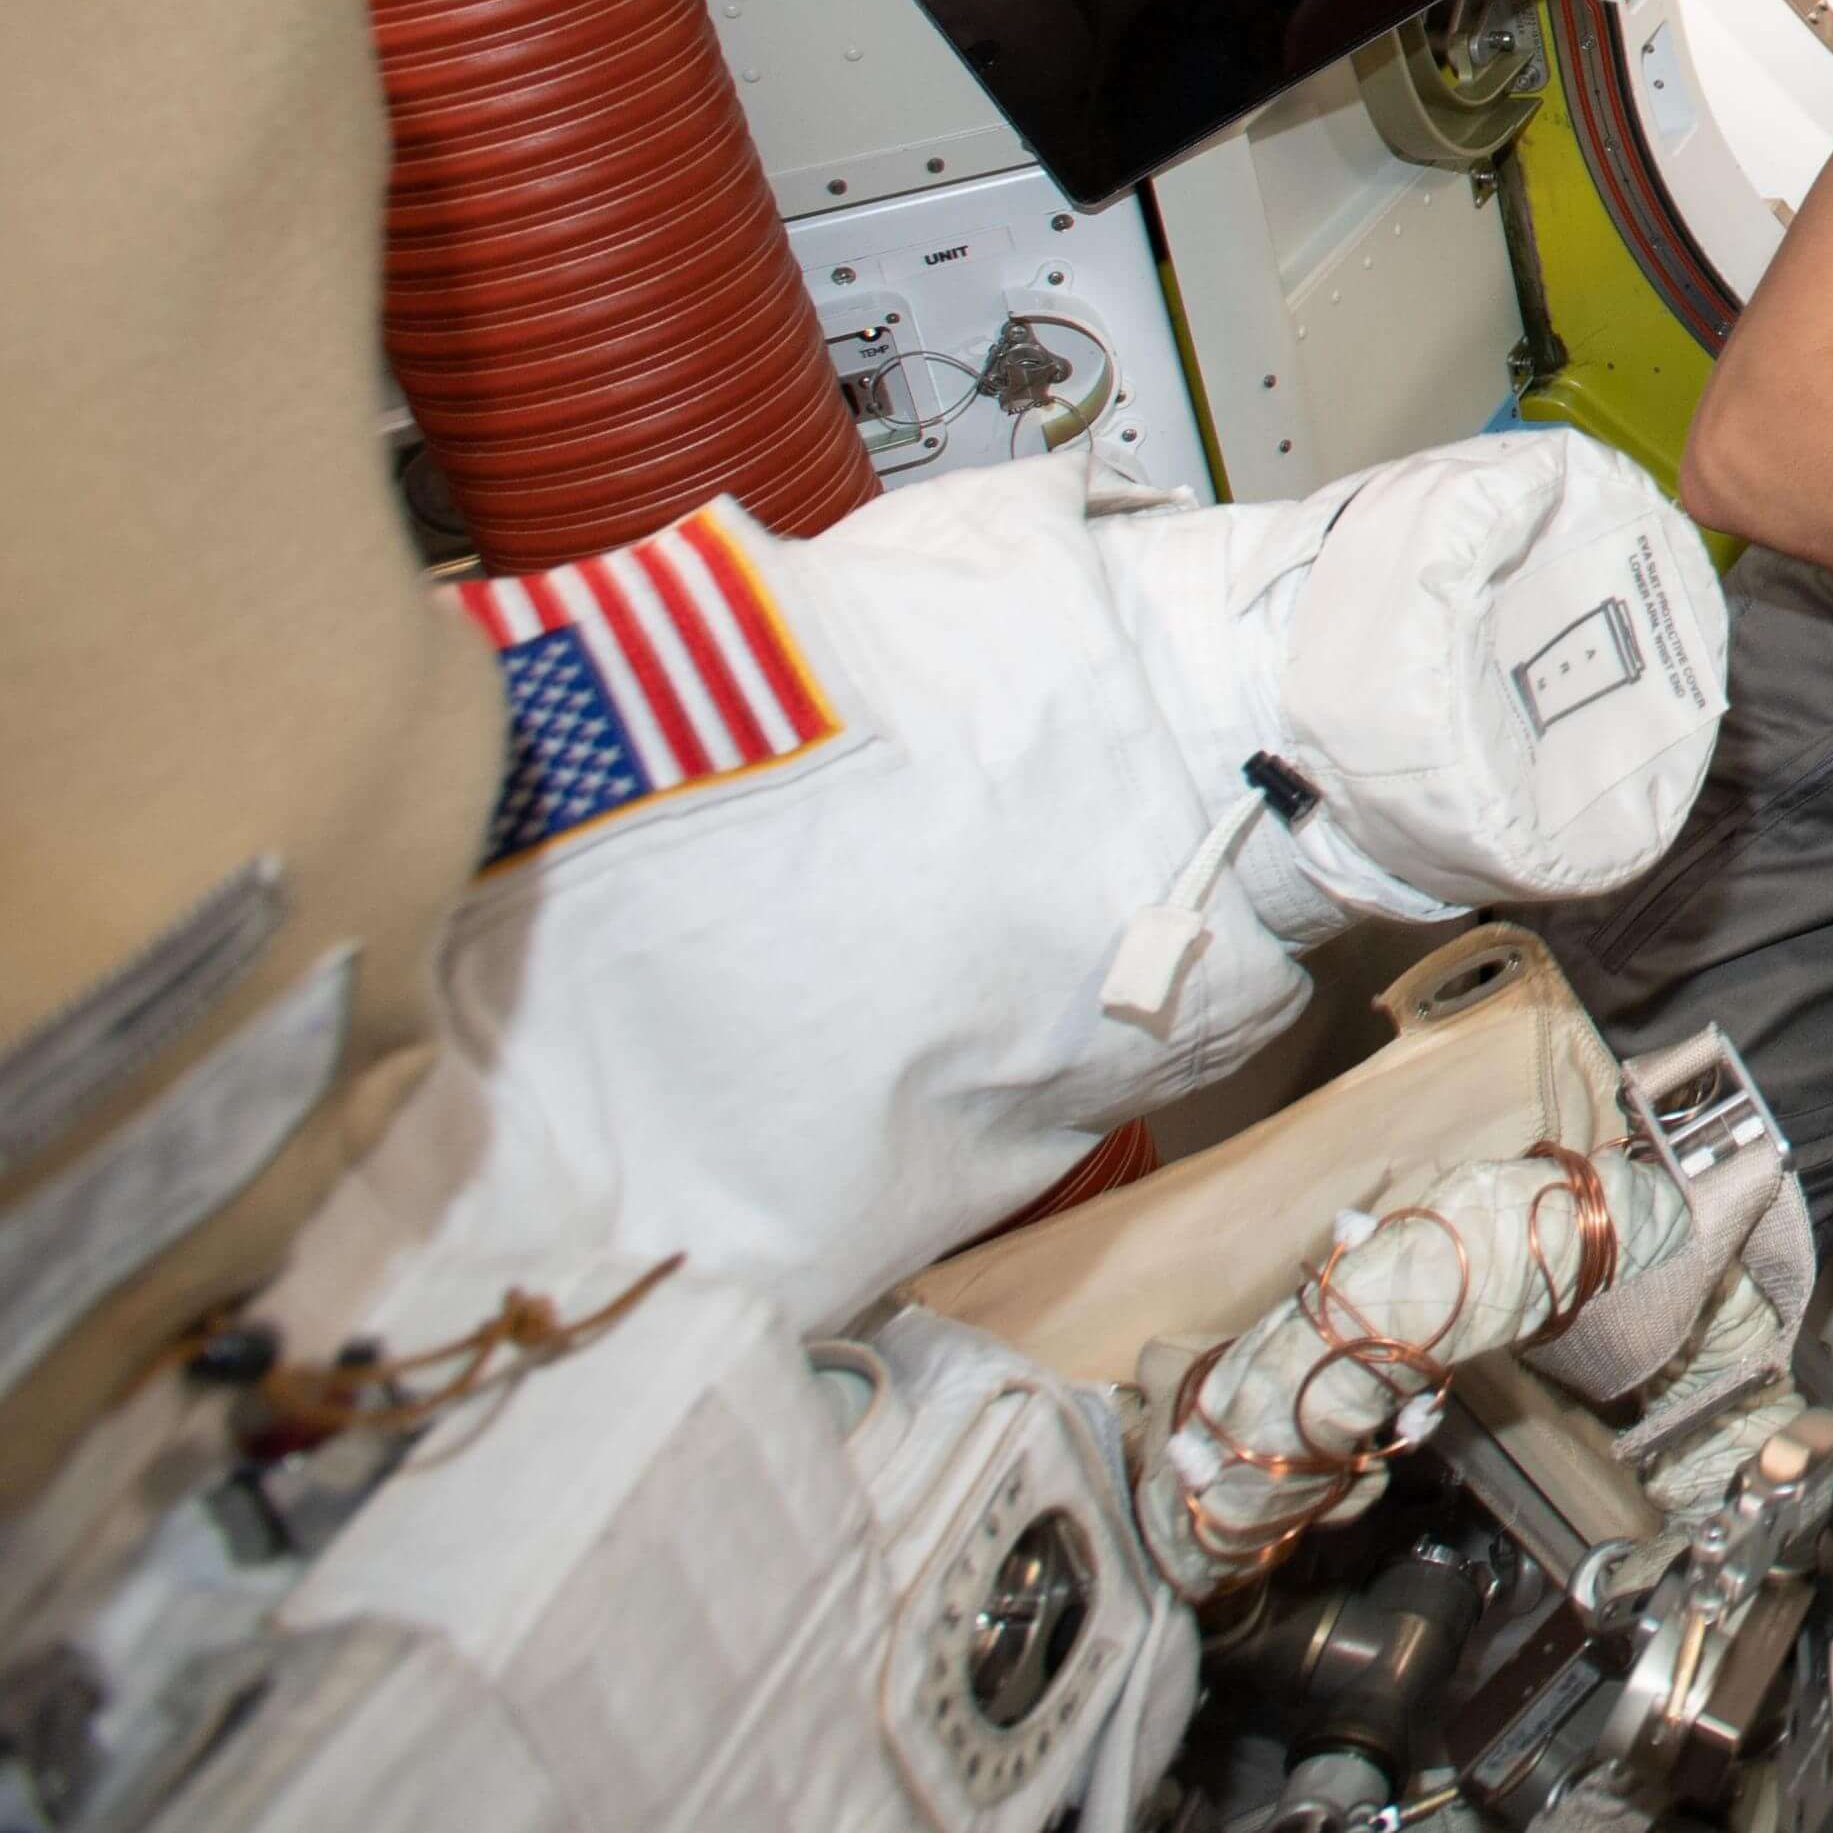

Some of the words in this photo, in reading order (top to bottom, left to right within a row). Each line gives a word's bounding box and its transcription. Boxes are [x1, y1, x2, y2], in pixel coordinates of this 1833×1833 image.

[924, 245, 969, 267] UNIT
[859, 343, 890, 359] TEMP
[1629, 554, 1650, 600] LOWER
[1669, 671, 1687, 699] END
[1638, 534, 1653, 561] EVA
[1656, 591, 1688, 665] PROTECTIVE
[1683, 666, 1706, 710] COVER
